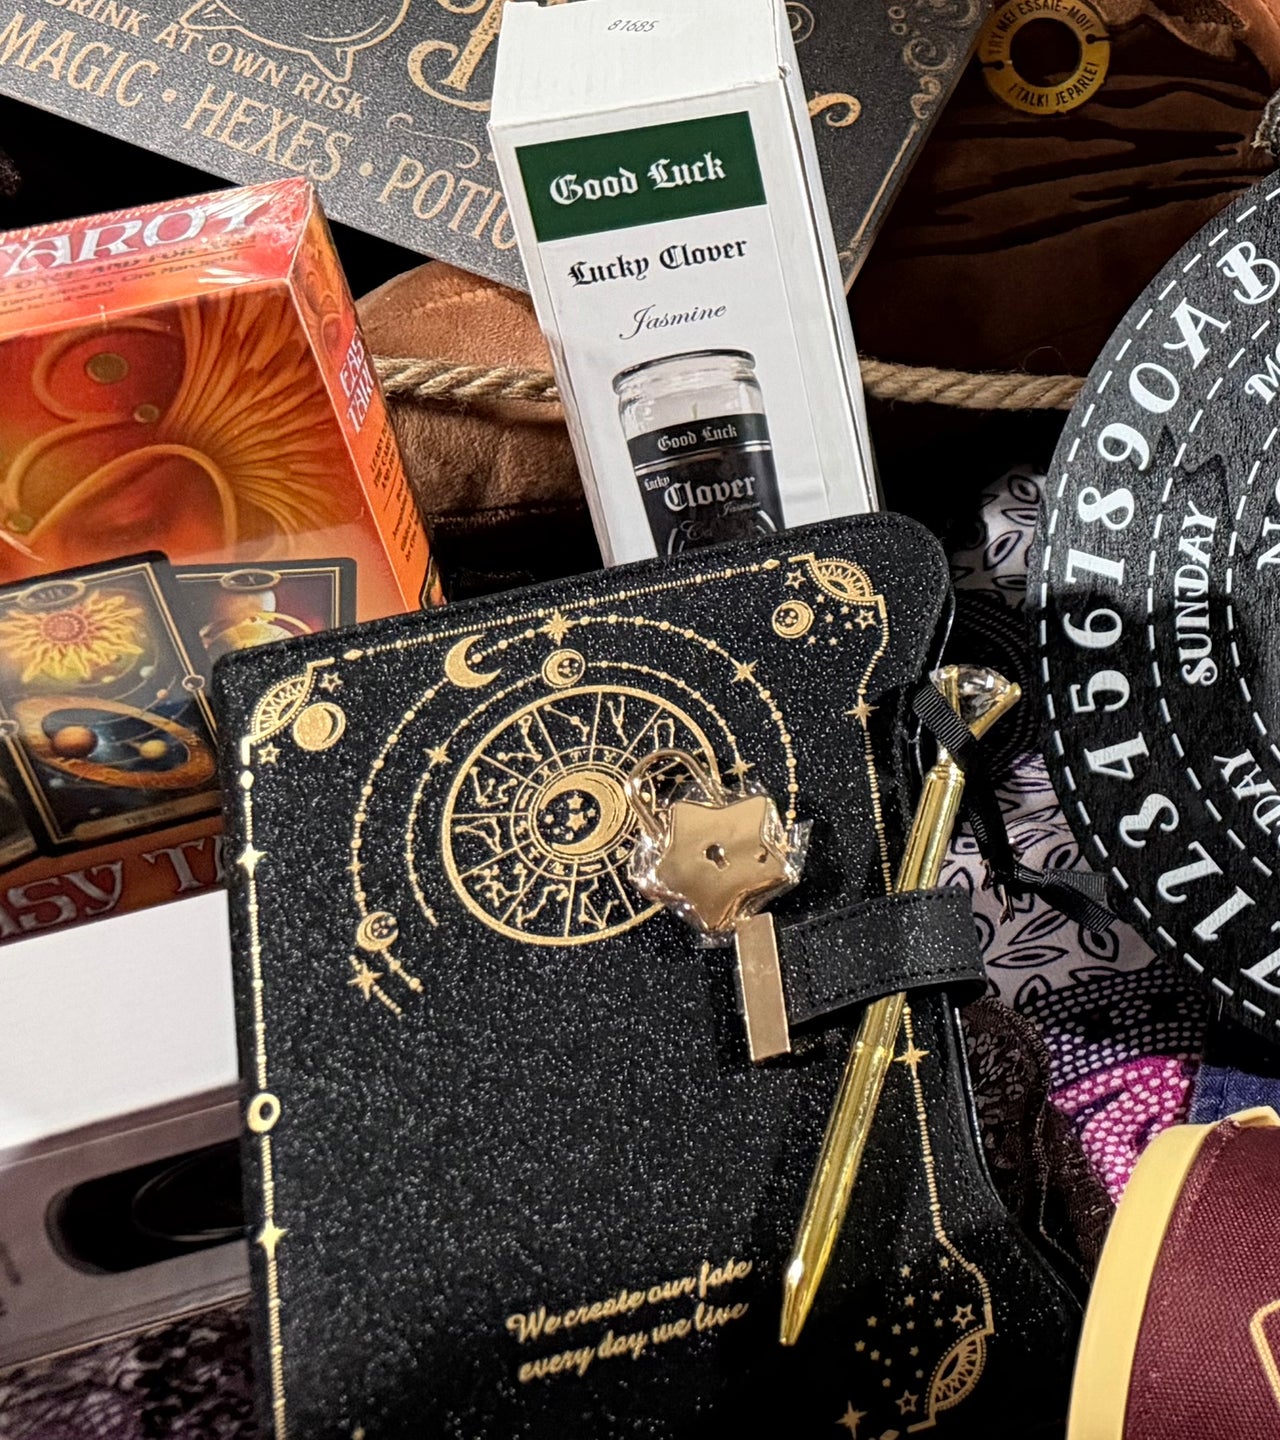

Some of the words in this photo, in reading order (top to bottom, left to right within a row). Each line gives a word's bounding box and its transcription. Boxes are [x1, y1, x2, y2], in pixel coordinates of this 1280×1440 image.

[606, 18, 660, 33] 81685
[156, 22, 206, 55] AT
[207, 41, 290, 89] OWN
[291, 71, 365, 120] RISK
[0, 11, 161, 108] MAGIC
[183, 82, 354, 183] HEXES
[549, 166, 639, 206] Good
[647, 152, 727, 191] Luck
[566, 254, 650, 288] Lucky
[659, 239, 748, 271] Clover
[618, 302, 727, 341] Jasmine
[656, 431, 698, 452] Good
[701, 423, 738, 443] Luck
[644, 474, 671, 492] Lucky
[663, 474, 756, 512] Clover
[1173, 501, 1218, 687] SUNDAY
[505, 1306, 561, 1344] We
[563, 1288, 645, 1328] create
[647, 1275, 697, 1304] our
[699, 1256, 753, 1298] fate
[518, 1346, 597, 1383] every
[597, 1328, 648, 1360] day
[651, 1317, 691, 1344] we
[694, 1301, 749, 1332] live
